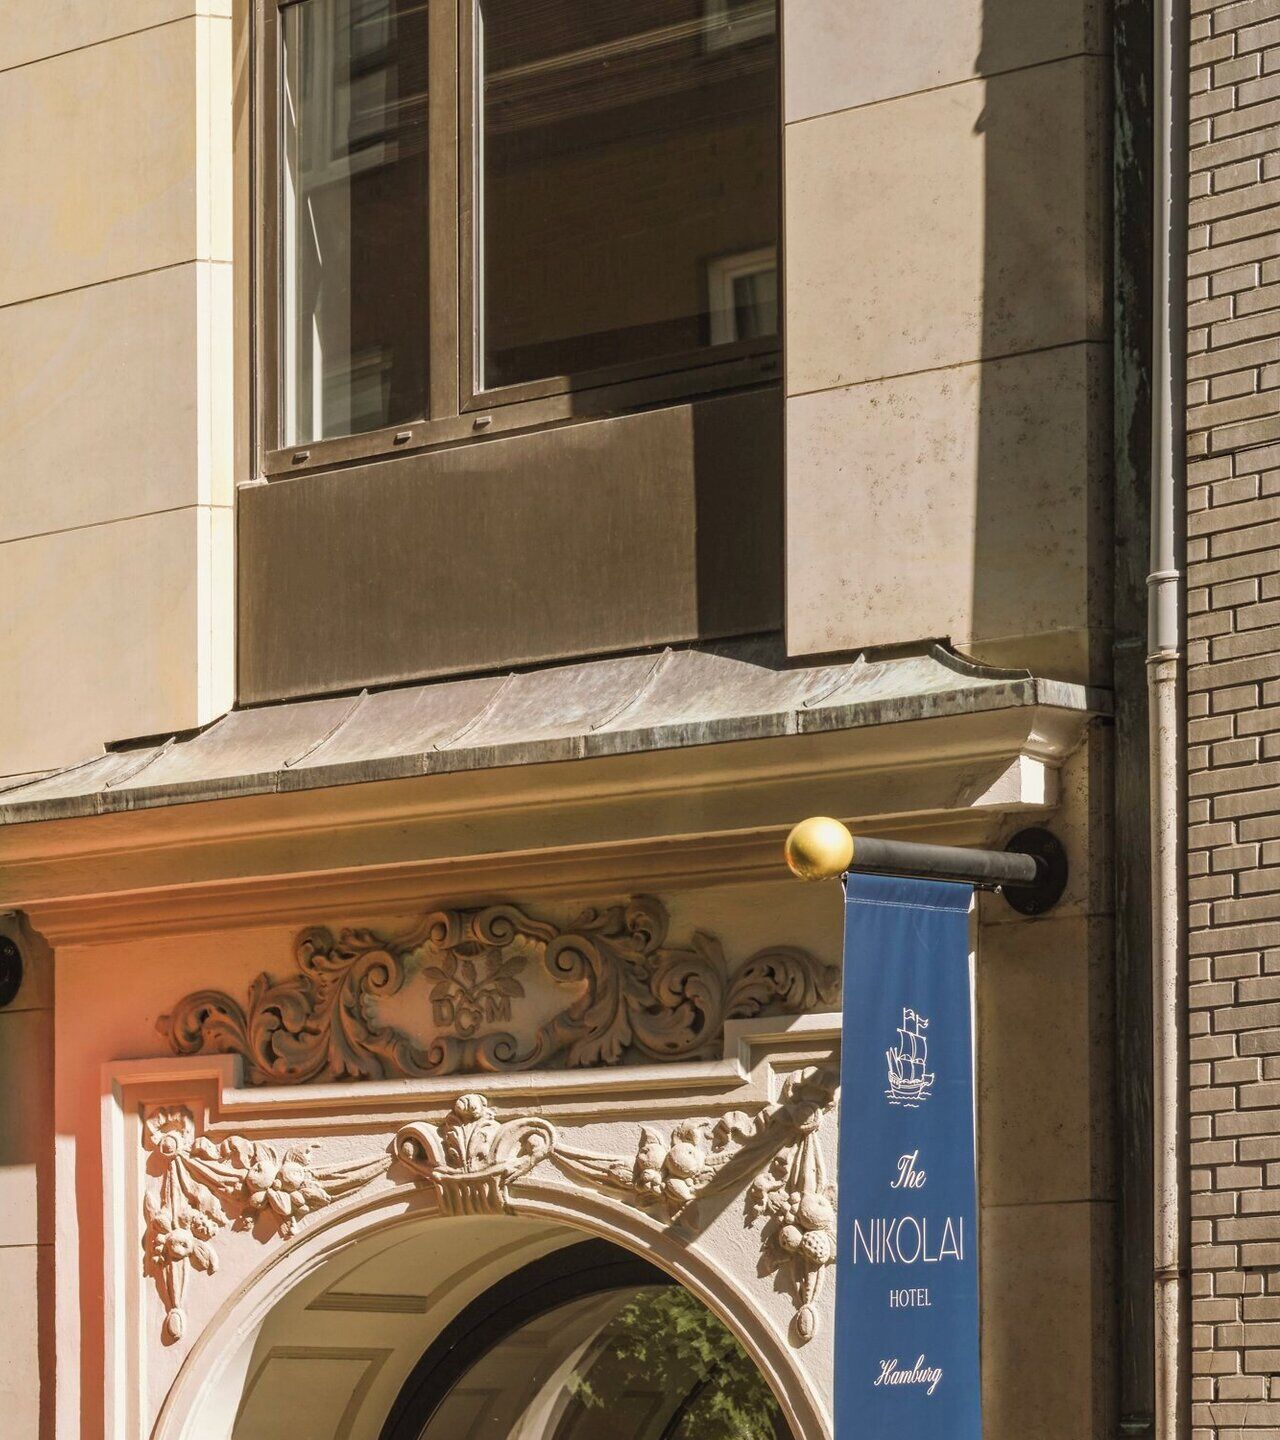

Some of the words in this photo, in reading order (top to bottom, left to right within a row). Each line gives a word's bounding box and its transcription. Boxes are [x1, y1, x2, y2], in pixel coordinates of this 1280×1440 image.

[890, 1150, 926, 1188] The
[853, 1216, 964, 1265] NIKOLAI
[890, 1288, 932, 1308] HOTEL
[873, 1354, 943, 1396] Hamburg
